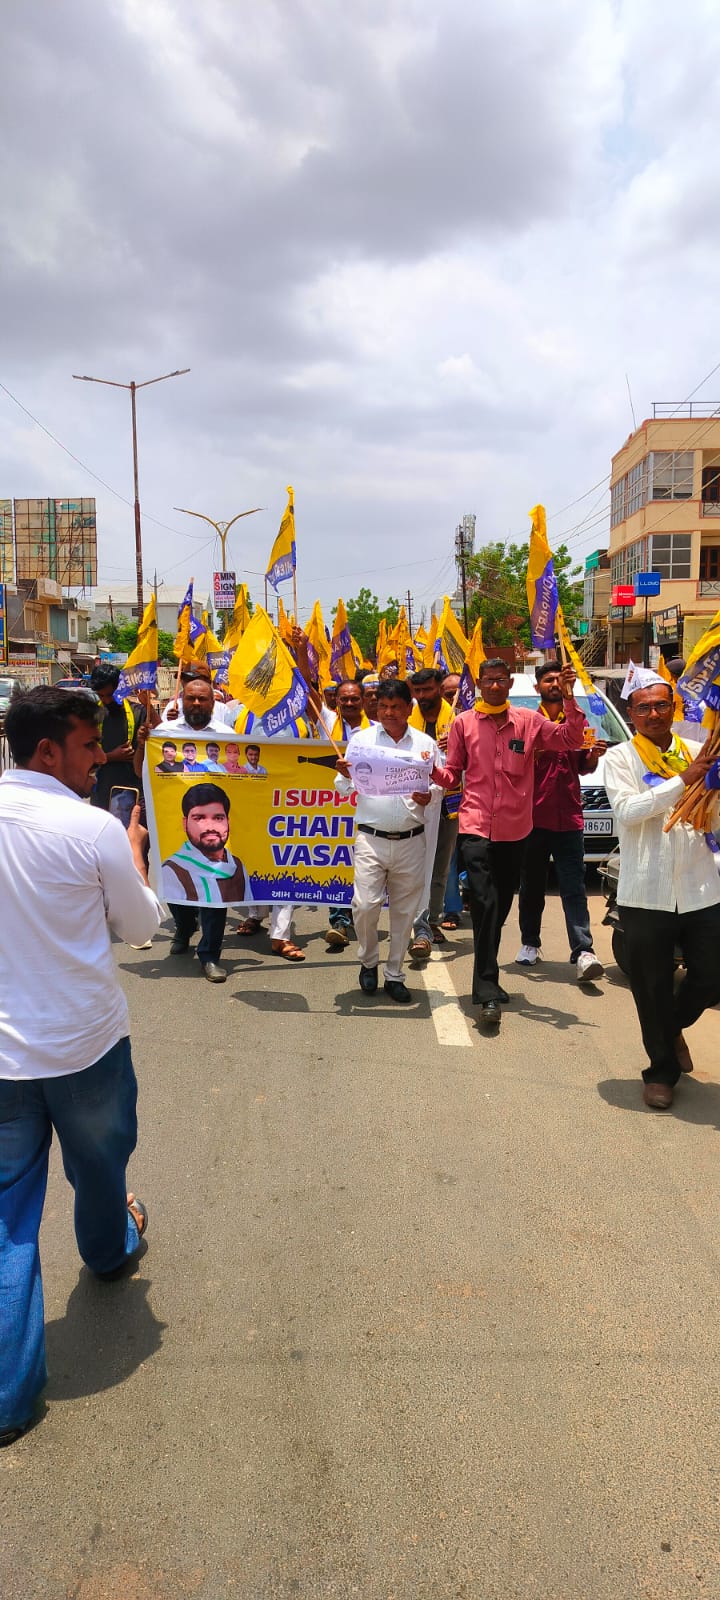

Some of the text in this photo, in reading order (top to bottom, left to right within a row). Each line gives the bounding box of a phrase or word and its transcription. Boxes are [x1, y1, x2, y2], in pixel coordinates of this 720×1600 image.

[214, 572, 235, 581] AMIN
[214, 582, 235, 591] SIGN
[273, 789, 281, 807] I
[271, 845, 355, 867] VASA
[271, 890, 290, 899] આમ
[294, 890, 323, 900] આદમી
